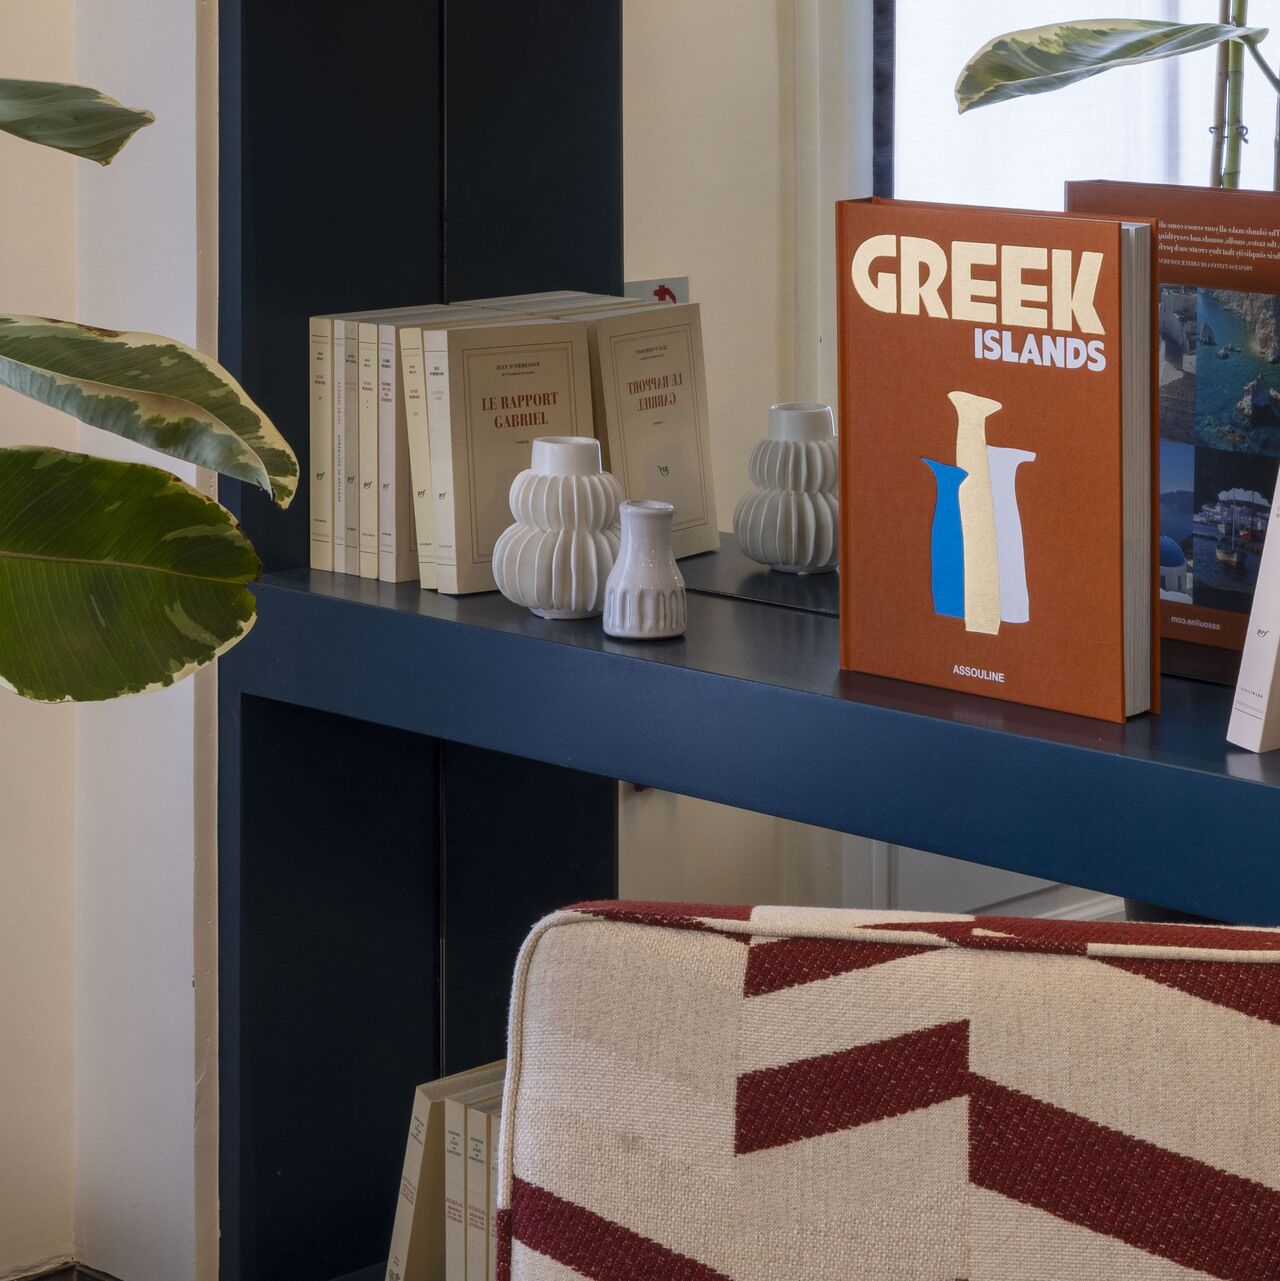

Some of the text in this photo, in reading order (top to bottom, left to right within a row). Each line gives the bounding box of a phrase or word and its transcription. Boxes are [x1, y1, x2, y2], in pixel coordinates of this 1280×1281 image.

[851, 235, 1106, 335] GREEK
[975, 328, 1106, 371] ISLANDS
[481, 392, 558, 411] LE RAPPORT
[494, 412, 549, 429] GABRIEL
[953, 665, 1005, 683] ASSOULINE
